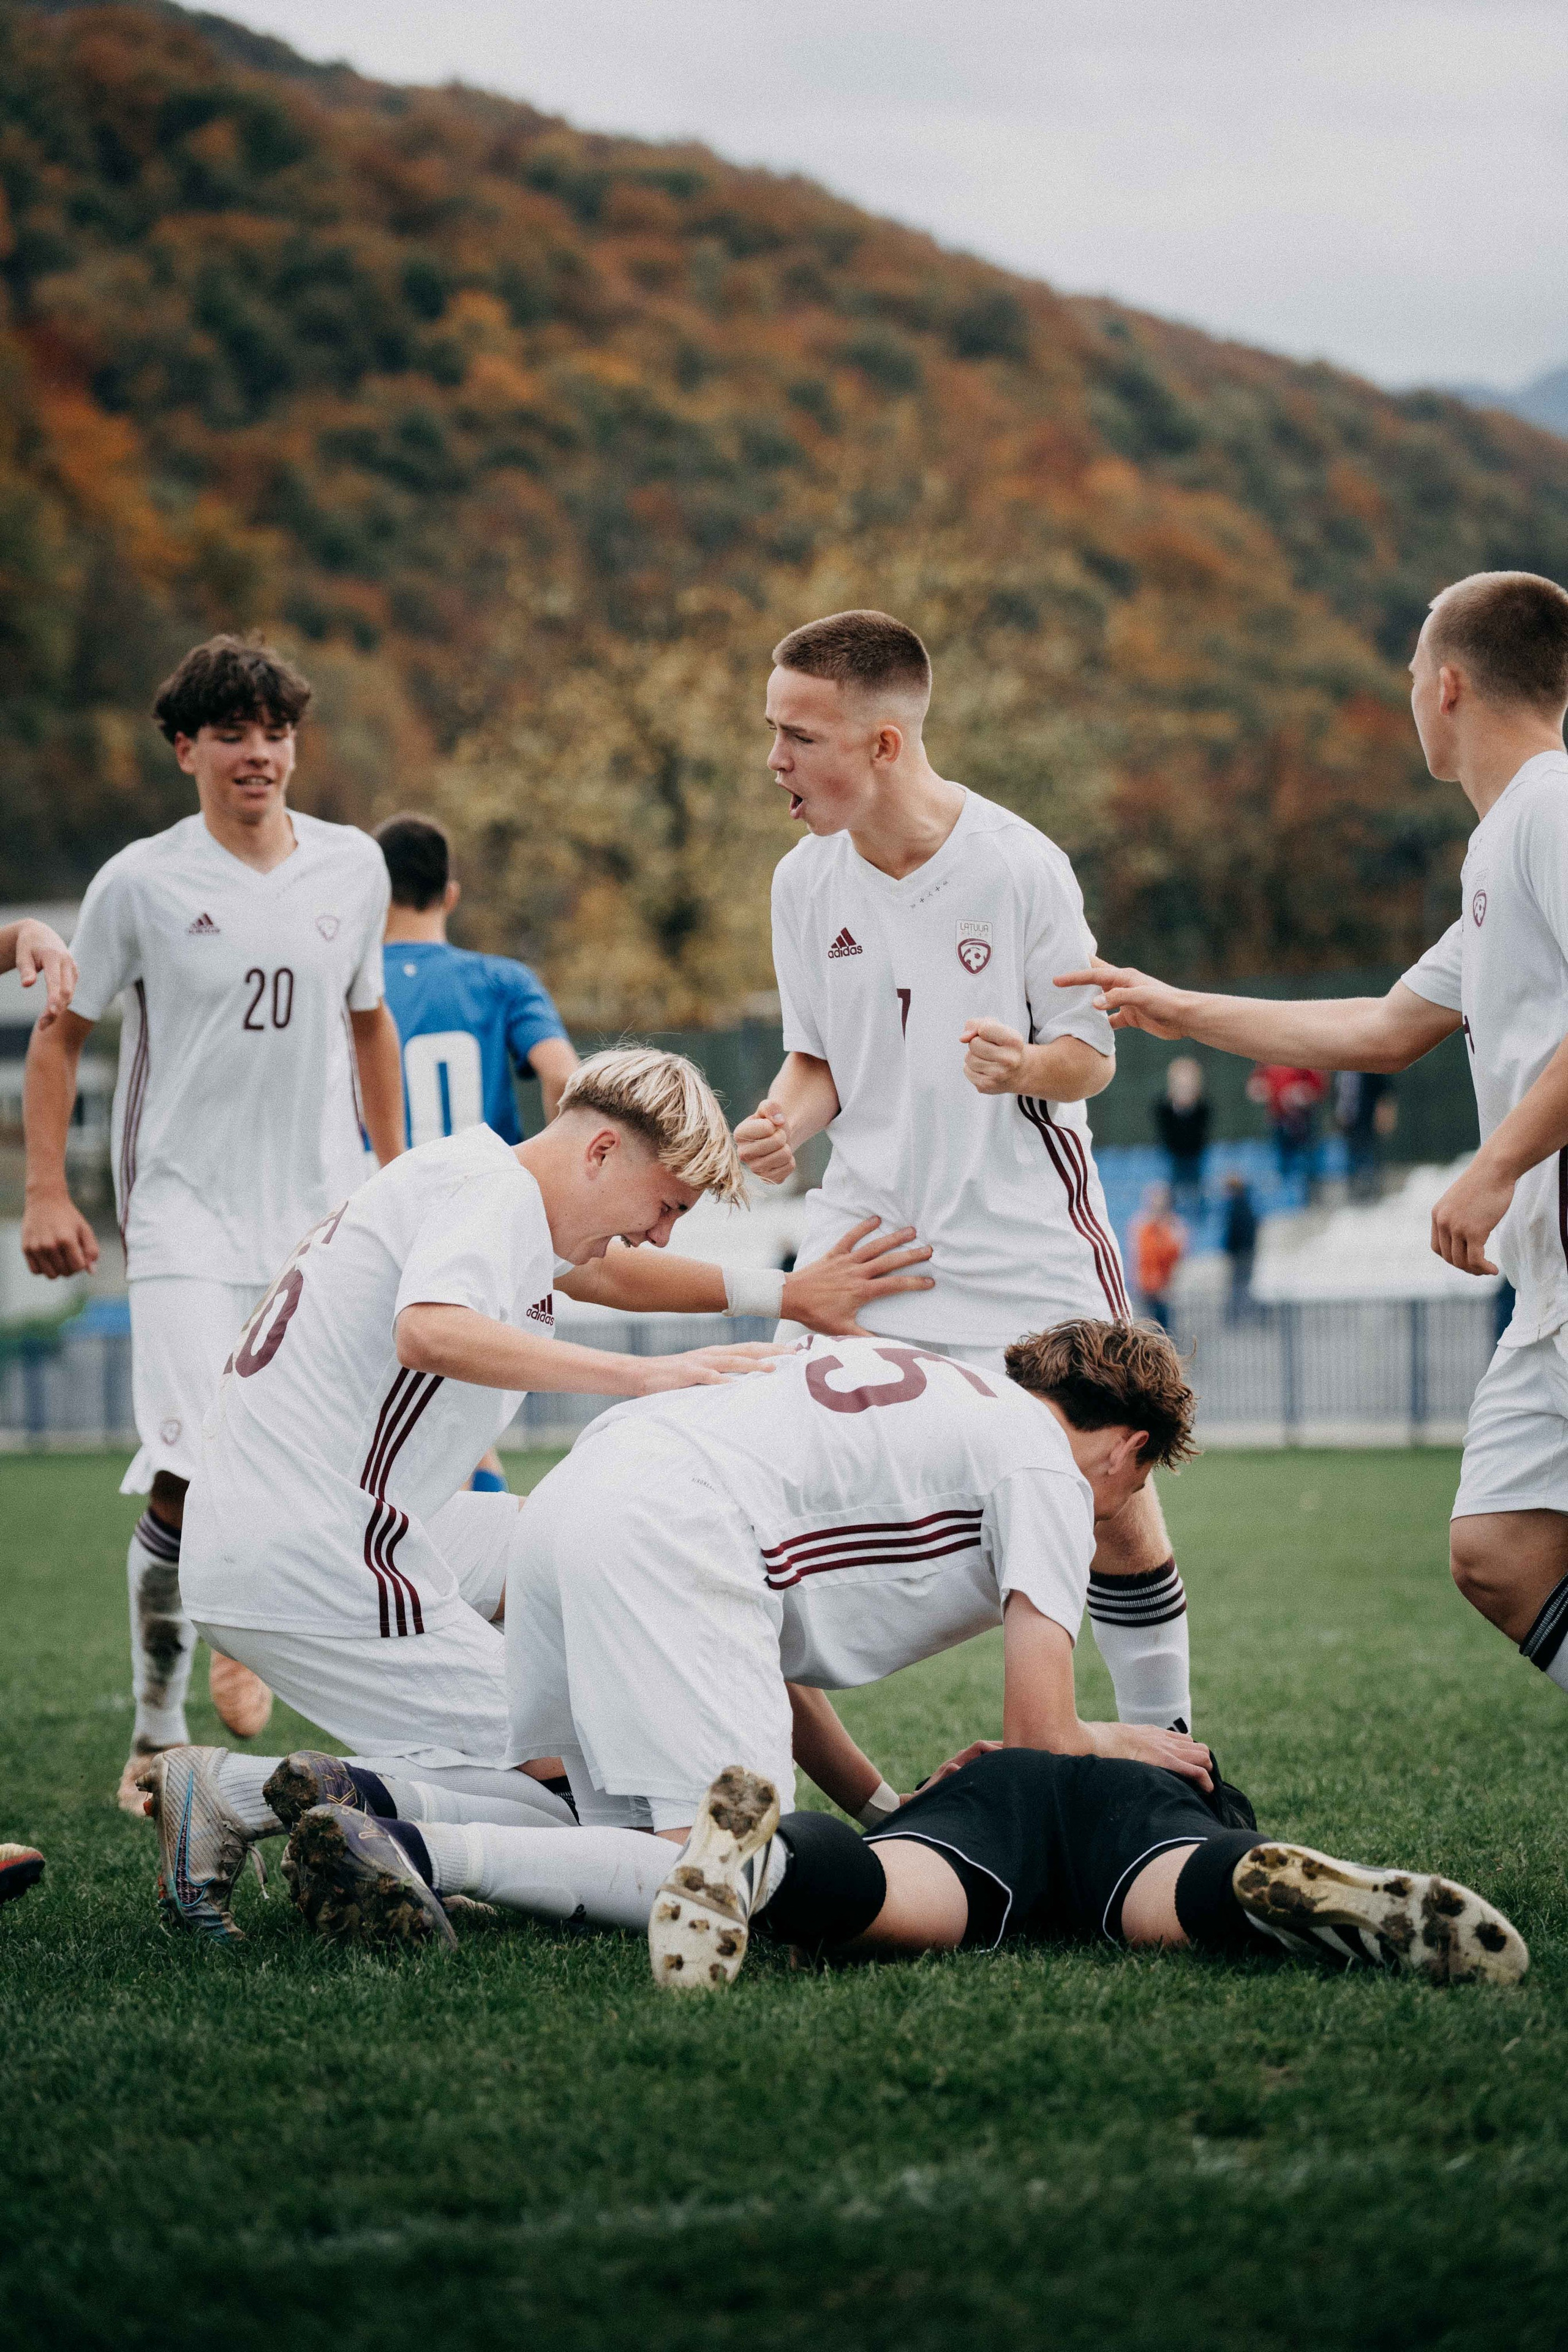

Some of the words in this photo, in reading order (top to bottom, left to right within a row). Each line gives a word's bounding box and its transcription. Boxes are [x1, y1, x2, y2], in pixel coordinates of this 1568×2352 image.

[960, 922, 989, 932] LATVIJA
[828, 945, 863, 959] adidas
[243, 967, 293, 1030] 20
[223, 1265, 304, 1378] 0
[526, 1308, 554, 1326] adidas
